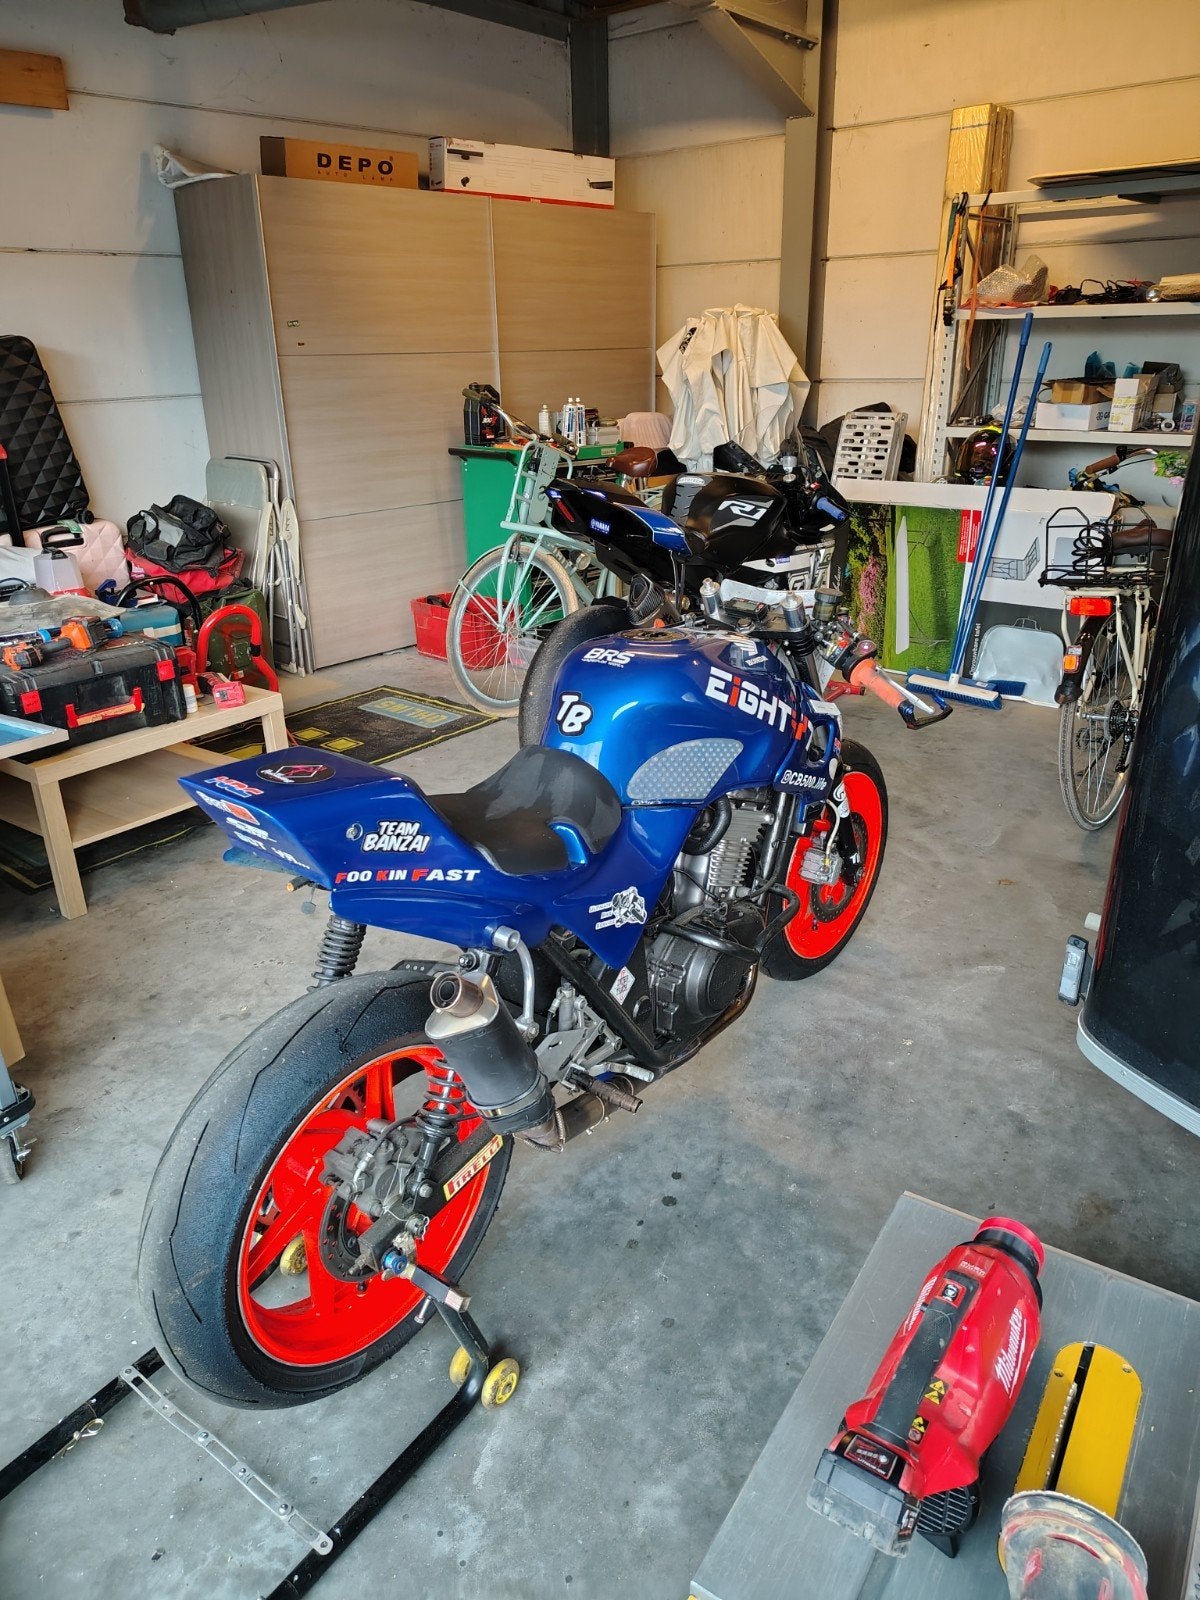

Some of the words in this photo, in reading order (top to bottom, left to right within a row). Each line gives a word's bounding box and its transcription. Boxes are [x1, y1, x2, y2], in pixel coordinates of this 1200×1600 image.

[316, 152, 394, 175] DEPO
[717, 500, 768, 520] R1
[583, 647, 636, 665] BRS
[379, 821, 420, 836] TEAM
[362, 833, 431, 852] BANZAI
[335, 871, 373, 884] FOO
[375, 869, 408, 881] KIN
[411, 868, 481, 882] FAST
[446, 1135, 501, 1196] PIRELLI
[994, 1307, 1025, 1397] Milwaukee
